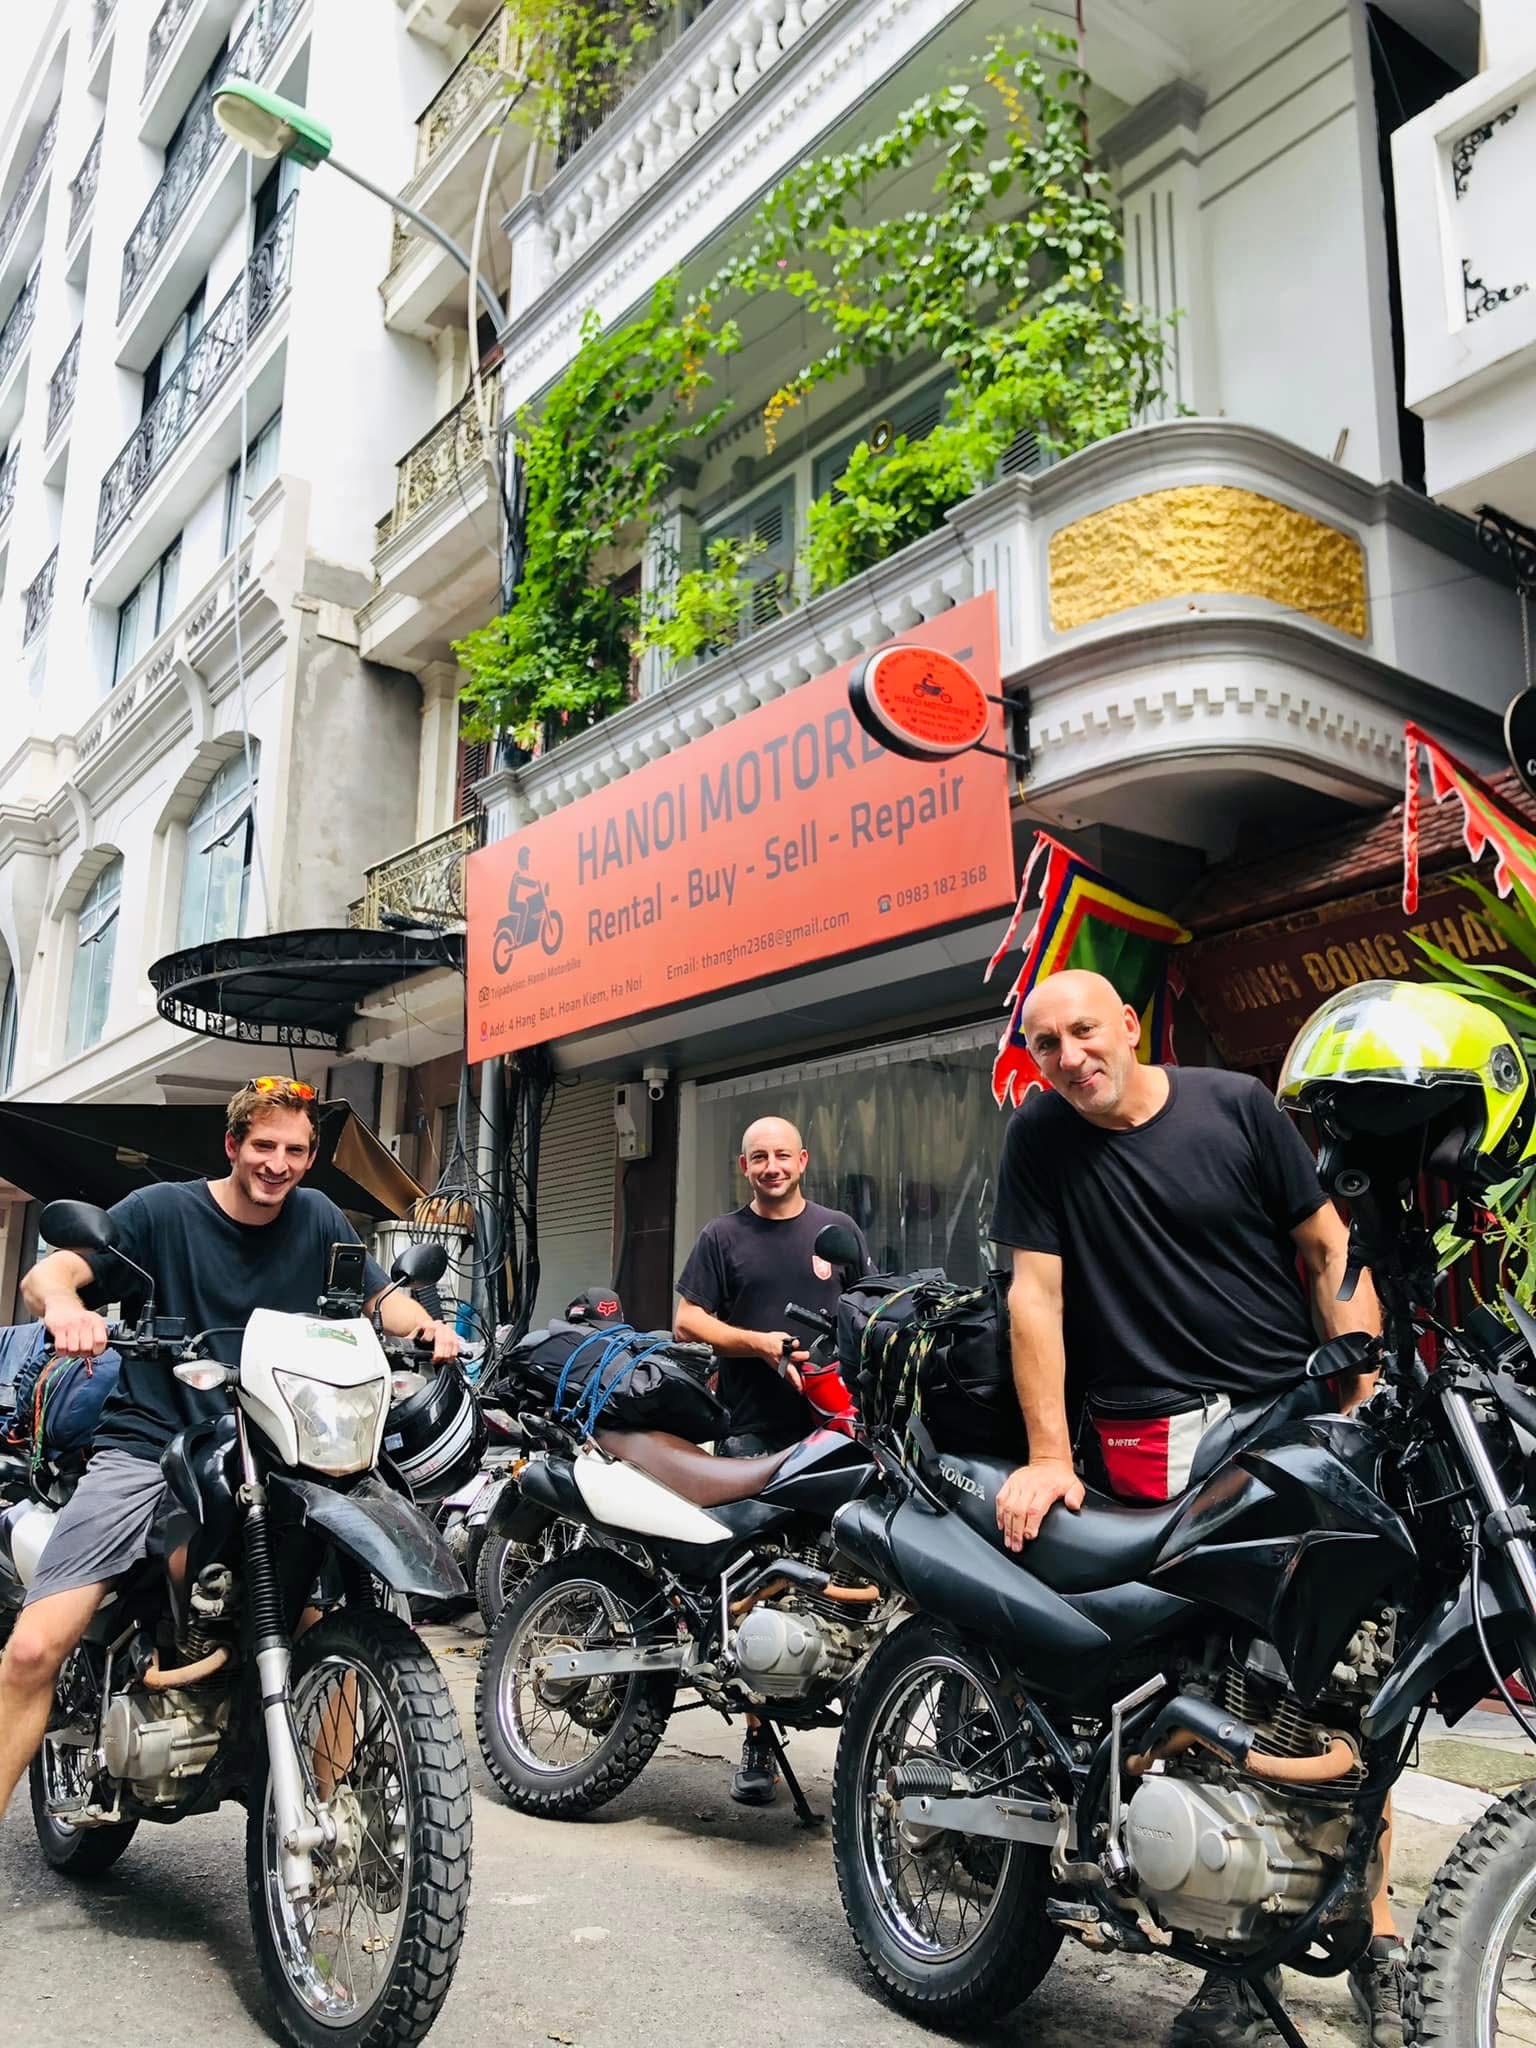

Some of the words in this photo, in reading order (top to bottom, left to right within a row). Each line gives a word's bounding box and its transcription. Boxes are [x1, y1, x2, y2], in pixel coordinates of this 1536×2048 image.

[578, 783, 687, 885] HANOI
[588, 882, 662, 945] Rental
[688, 863, 736, 908] Buy
[765, 819, 817, 879] Sell
[851, 767, 964, 848] Repair
[896, 883, 929, 908] 0983
[933, 874, 957, 897] 182
[960, 864, 987, 888] 368
[666, 956, 699, 980] Email:
[701, 911, 851, 969] thanghn2368@gmail.com
[1301, 934, 1410, 993] ĐÔNG
[489, 1020, 508, 1039] Add:
[509, 1018, 514, 1031] 4
[515, 1013, 537, 1030] Hang
[558, 1000, 582, 1016] Hoan
[610, 983, 625, 998] Ha
[625, 974, 643, 994] Noi
